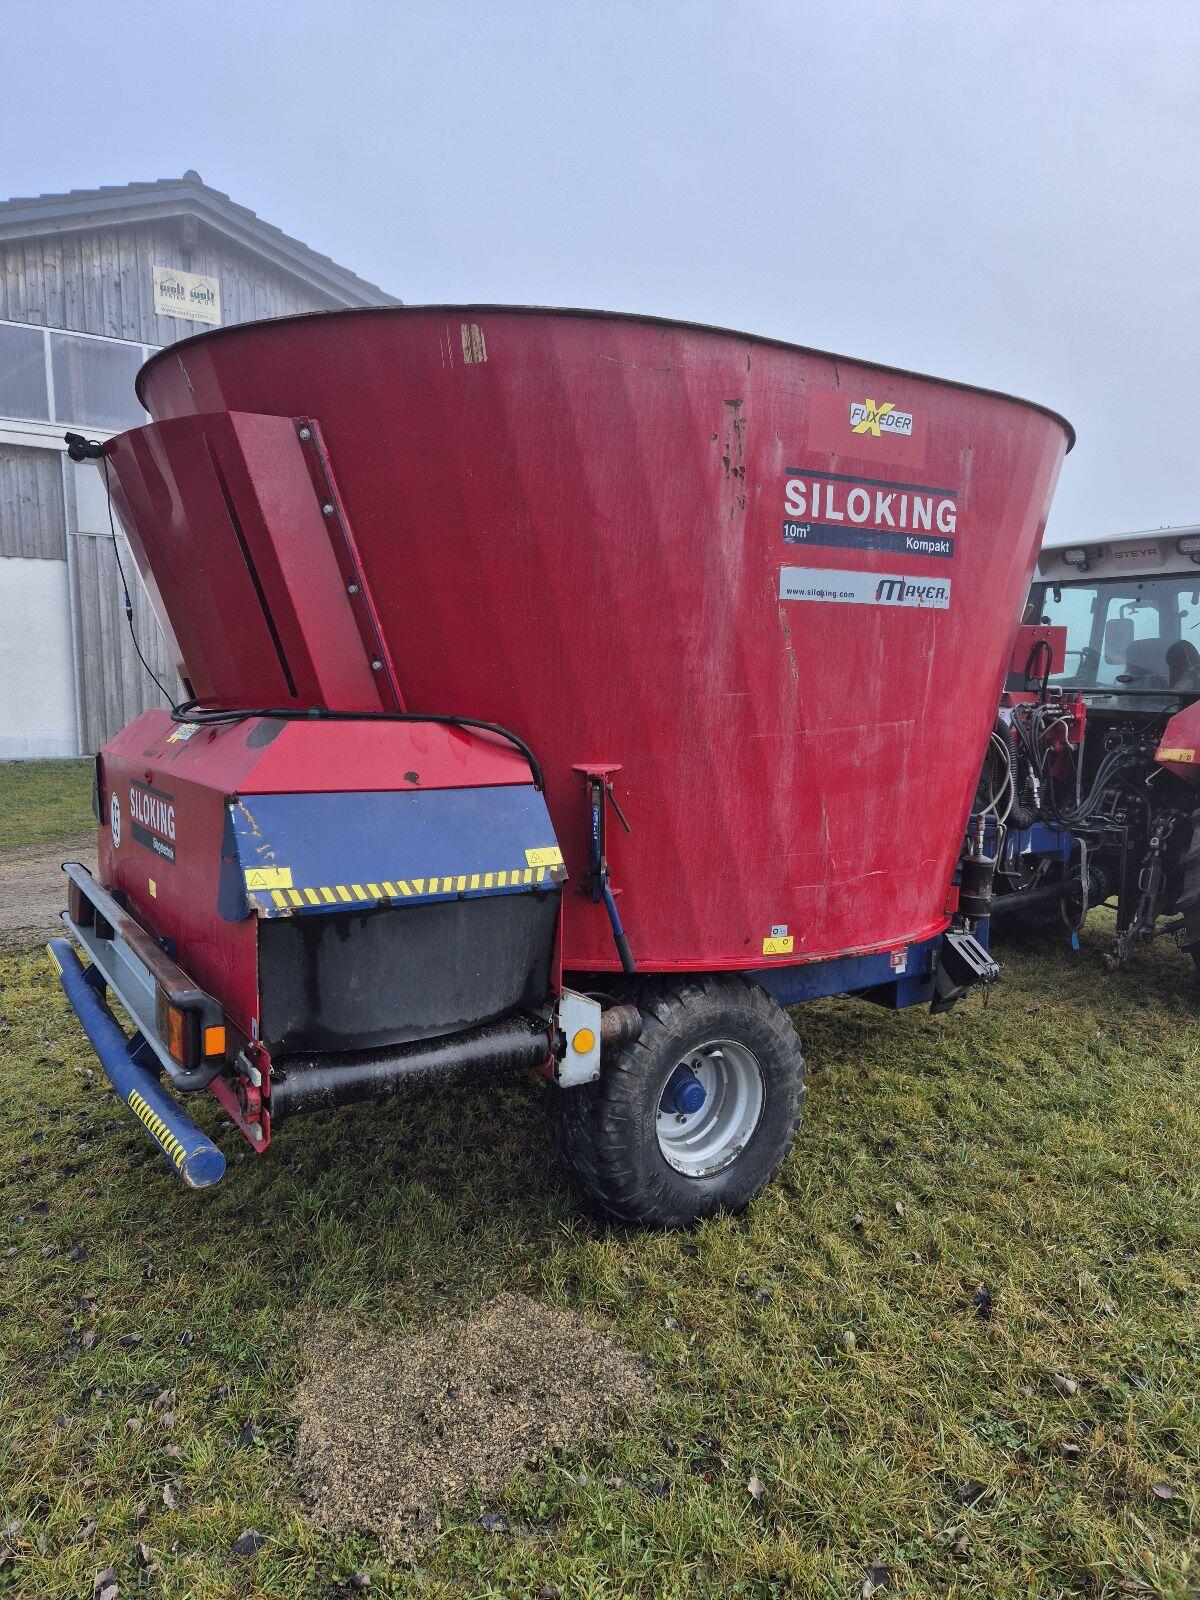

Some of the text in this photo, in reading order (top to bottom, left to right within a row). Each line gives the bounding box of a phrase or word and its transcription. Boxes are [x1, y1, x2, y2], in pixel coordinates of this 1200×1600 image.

[784, 479, 957, 533] SILOKING
[906, 536, 950, 553] Kompakt
[1113, 548, 1158, 559] STEYR
[786, 587, 855, 599] www.siloking.com
[130, 787, 176, 841] SILOKING
